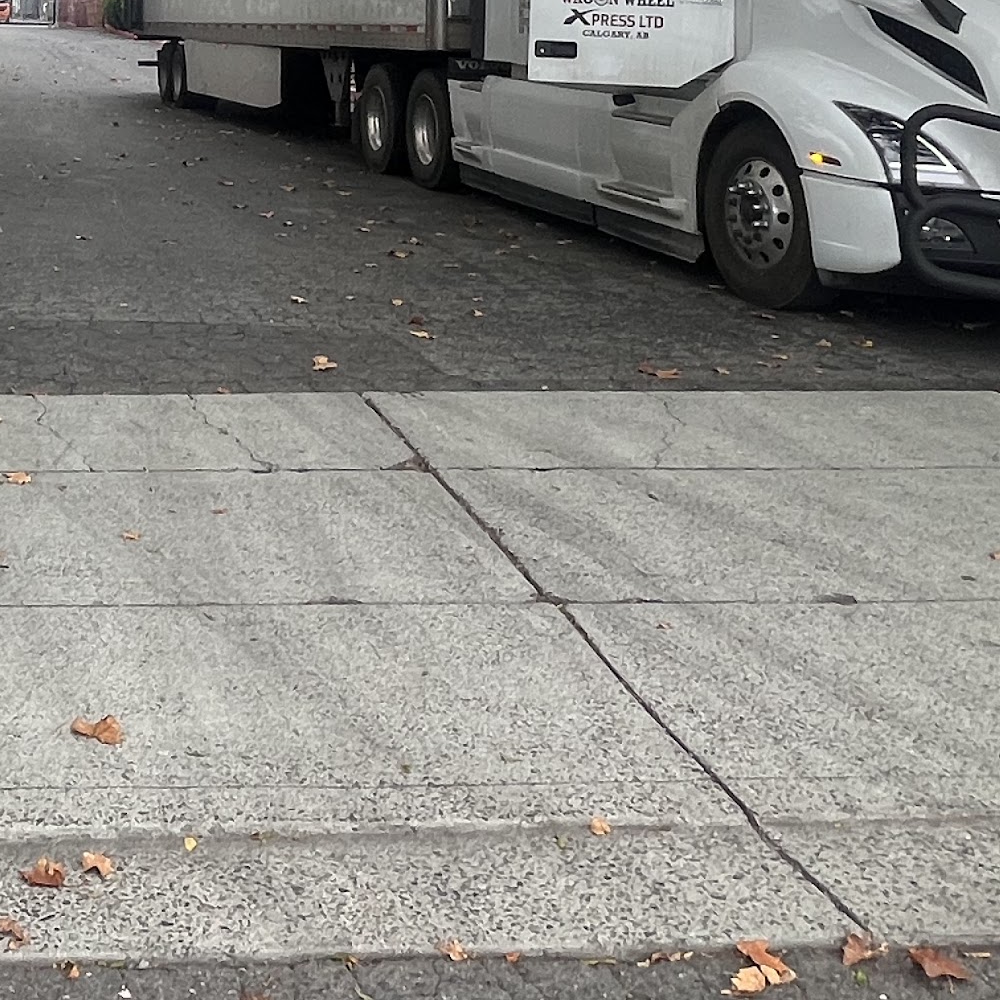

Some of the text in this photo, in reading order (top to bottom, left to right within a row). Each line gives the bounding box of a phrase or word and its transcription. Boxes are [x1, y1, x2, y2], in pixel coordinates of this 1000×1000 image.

[563, 9, 665, 29] XPRESS LTD
[636, 32, 650, 40] AB
